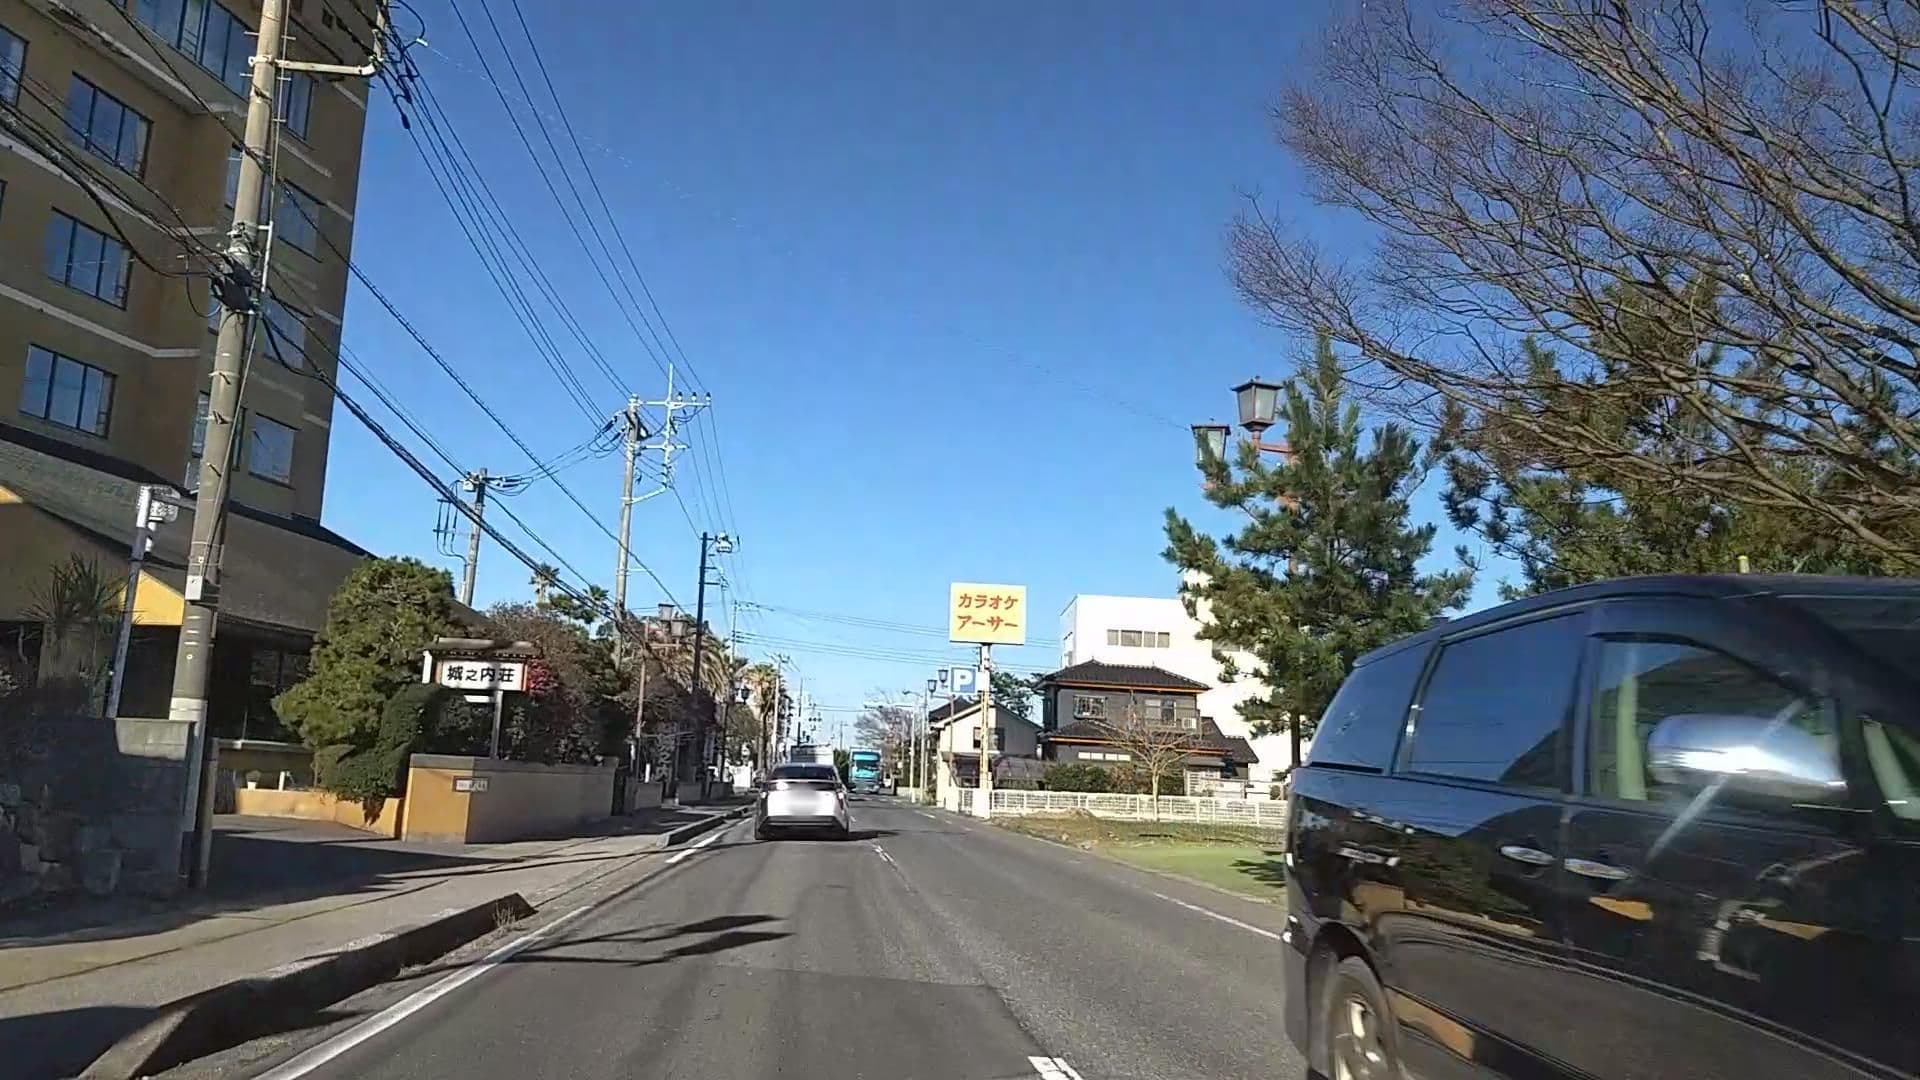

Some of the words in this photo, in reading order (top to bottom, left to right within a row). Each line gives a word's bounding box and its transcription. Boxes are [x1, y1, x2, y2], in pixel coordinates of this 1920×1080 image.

[958, 593, 1018, 610] カラオケ
[957, 615, 1018, 631] アーサー
[447, 666, 514, 683] 城之内荘
[954, 672, 973, 690] P
